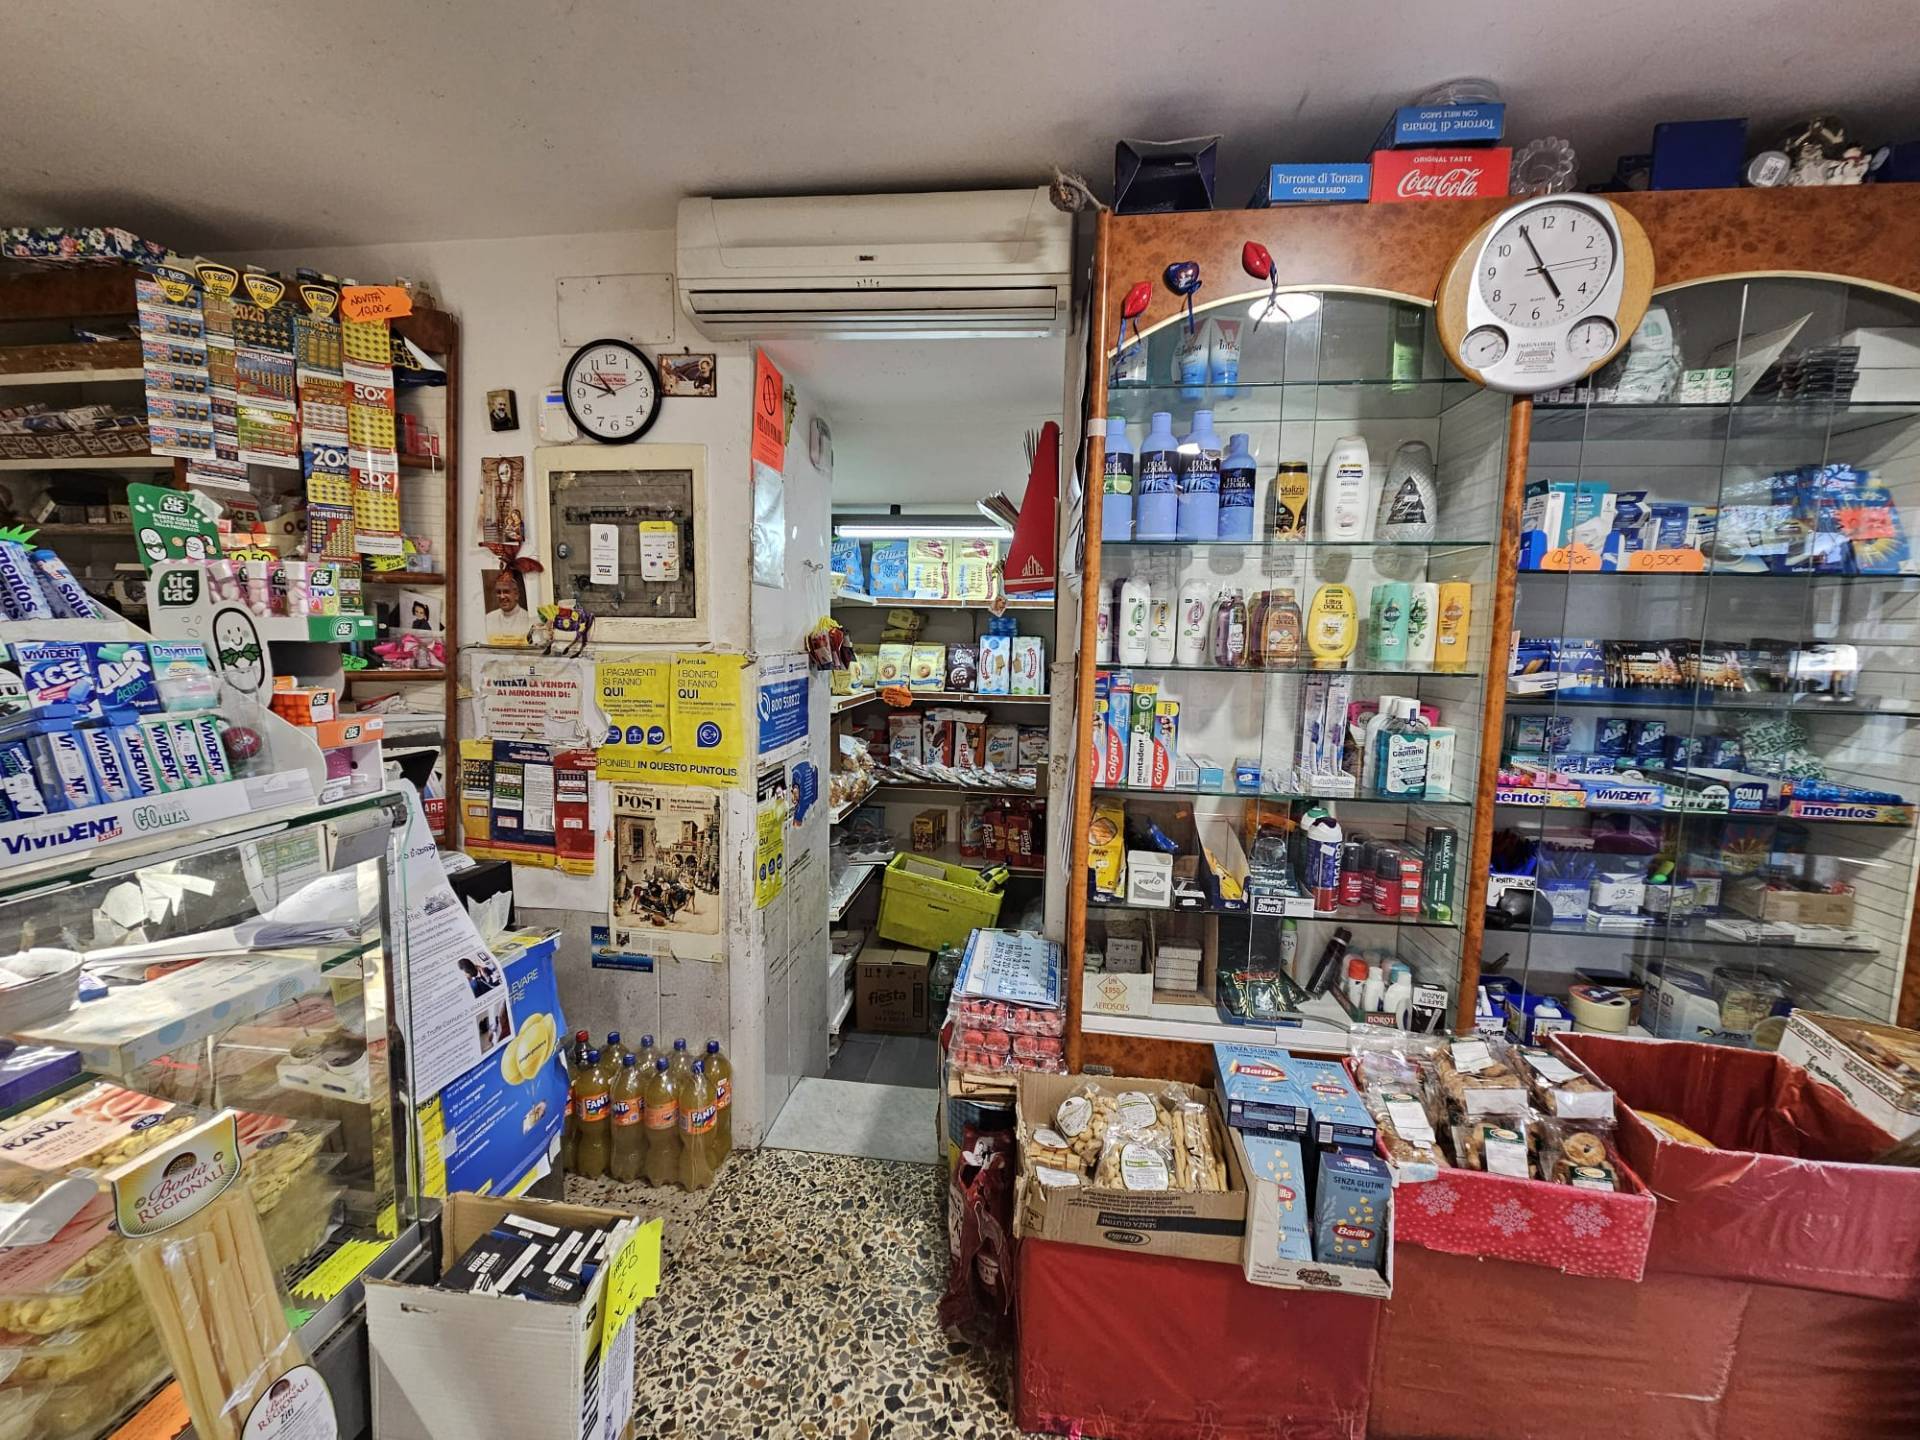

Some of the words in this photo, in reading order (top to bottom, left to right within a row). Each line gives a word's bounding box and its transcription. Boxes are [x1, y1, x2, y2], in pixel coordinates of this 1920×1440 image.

[1463, 110, 1479, 118] CON
[1402, 119, 1438, 132] Tonara
[1441, 119, 1451, 131] di
[1454, 119, 1495, 131] Torrone
[1450, 155, 1472, 163] TASTE
[1278, 174, 1315, 184] Torrone
[1317, 173, 1329, 184] di
[1331, 173, 1363, 184] Tonara
[1397, 168, 1484, 197] Coca-Cola
[1293, 187, 1307, 195] CON
[1308, 187, 1325, 195] MIELE
[1326, 187, 1346, 195] SARDO
[1542, 216, 1556, 230] 12
[1585, 235, 1595, 249] 2
[1498, 244, 1512, 257] 10
[1588, 257, 1598, 271] 3
[1487, 267, 1497, 280] 9
[1577, 281, 1587, 295] 4
[1492, 289, 1502, 302] 8
[1508, 303, 1517, 317] 7
[1556, 298, 1565, 312] 5
[233, 304, 265, 322] 2026
[1531, 307, 1540, 320] 6
[590, 360, 599, 370] 11
[605, 353, 617, 365] 12
[580, 372, 592, 383] 10
[634, 370, 643, 381] 2
[577, 387, 586, 399] 9
[639, 387, 648, 398] 3
[583, 403, 592, 415] 8
[636, 405, 645, 415] 4
[597, 416, 605, 427] 7
[610, 420, 619, 431] 6
[625, 416, 634, 427] 5
[0, 546, 38, 613] mentos
[168, 571, 194, 588] tic
[313, 577, 329, 585] tac
[317, 571, 329, 580] tic
[163, 585, 194, 602] tac
[310, 587, 335, 596] TWO
[154, 646, 204, 661] Daygum
[31, 661, 82, 689] ICE
[96, 650, 150, 695] AIR
[606, 668, 656, 677] PAGAMENTI
[682, 670, 719, 678] BONIFICI
[493, 679, 528, 688] VIETATA
[529, 680, 539, 688] LA
[540, 681, 577, 689] VENDITA
[602, 677, 611, 685] SI
[612, 678, 642, 686] FANNO
[678, 679, 686, 687] SI
[687, 680, 717, 688] FANNO
[116, 679, 146, 702] Action
[508, 689, 557, 697] MINORENNI
[771, 697, 782, 712] 800
[1108, 735, 1118, 781] Colgate
[637, 761, 647, 769] IN
[649, 762, 688, 772] QUESTO
[690, 763, 737, 776] PUNTOLIS
[1154, 746, 1164, 786] Colgate
[1735, 788, 1763, 801] GOLIA
[618, 794, 665, 811] POST
[133, 806, 190, 831] GOLIA
[1802, 806, 1878, 819] mentos
[1333, 843, 1344, 887] FIGARO
[1105, 986, 1121, 994] 1950
[1421, 991, 1445, 999] RAZOR
[869, 989, 906, 1005] fiesta
[1418, 999, 1445, 1007] SAFETY
[1093, 1002, 1130, 1011] AEROSOLS
[1240, 1066, 1279, 1077] Barilla
[1316, 1086, 1345, 1094] Barilla
[586, 1095, 609, 1110] FANT
[3, 1119, 73, 1151] RANA
[149, 1161, 208, 1207] Bontà
[1333, 1176, 1355, 1187] SENZA
[1356, 1179, 1384, 1190] GLUTINE
[137, 1164, 225, 1225] REGIONALI
[1100, 1219, 1134, 1227] GLUTINE
[1135, 1221, 1158, 1229] SENZA
[1337, 1227, 1370, 1238] Barilla
[257, 1378, 309, 1431] REGIONALI
